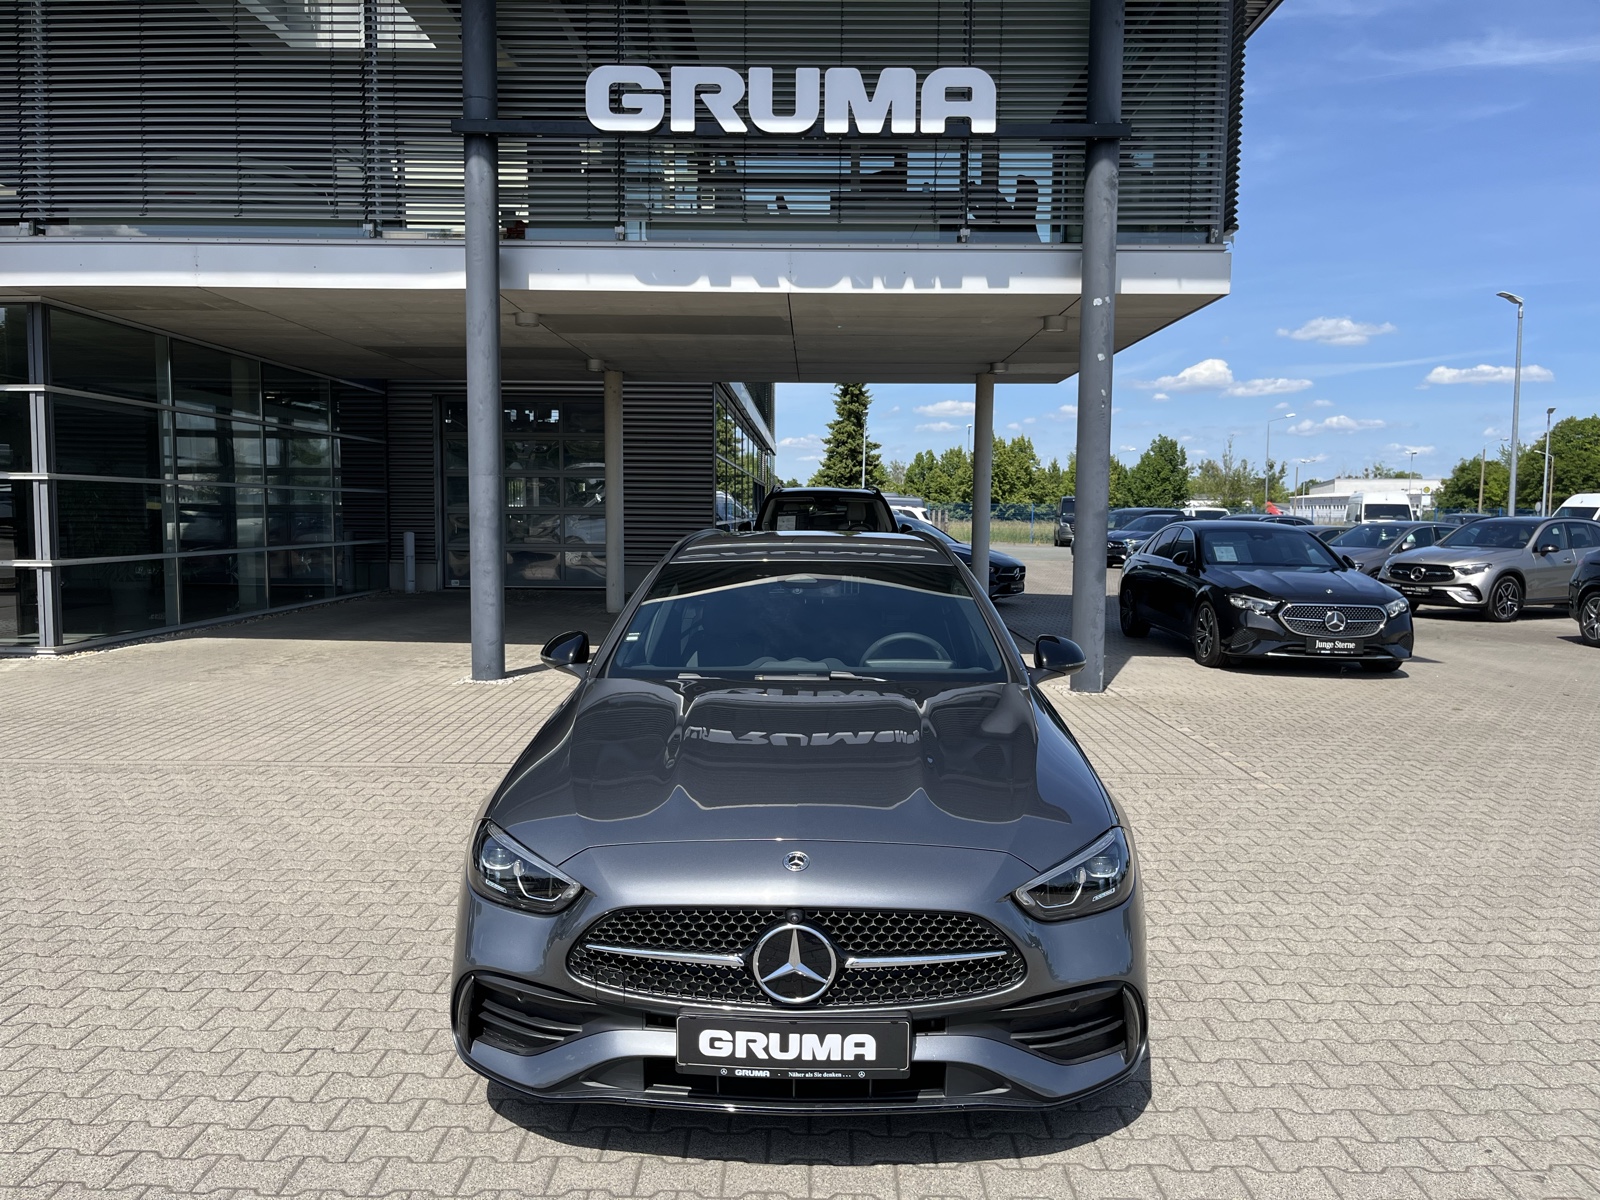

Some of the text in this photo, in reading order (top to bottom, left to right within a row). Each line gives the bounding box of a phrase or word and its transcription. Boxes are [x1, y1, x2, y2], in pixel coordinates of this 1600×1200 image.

[585, 65, 997, 135] GRUMA
[1315, 640, 1356, 649] Junge Sterne
[698, 1029, 877, 1061] GRUMA
[735, 1069, 770, 1078] GRUMA
